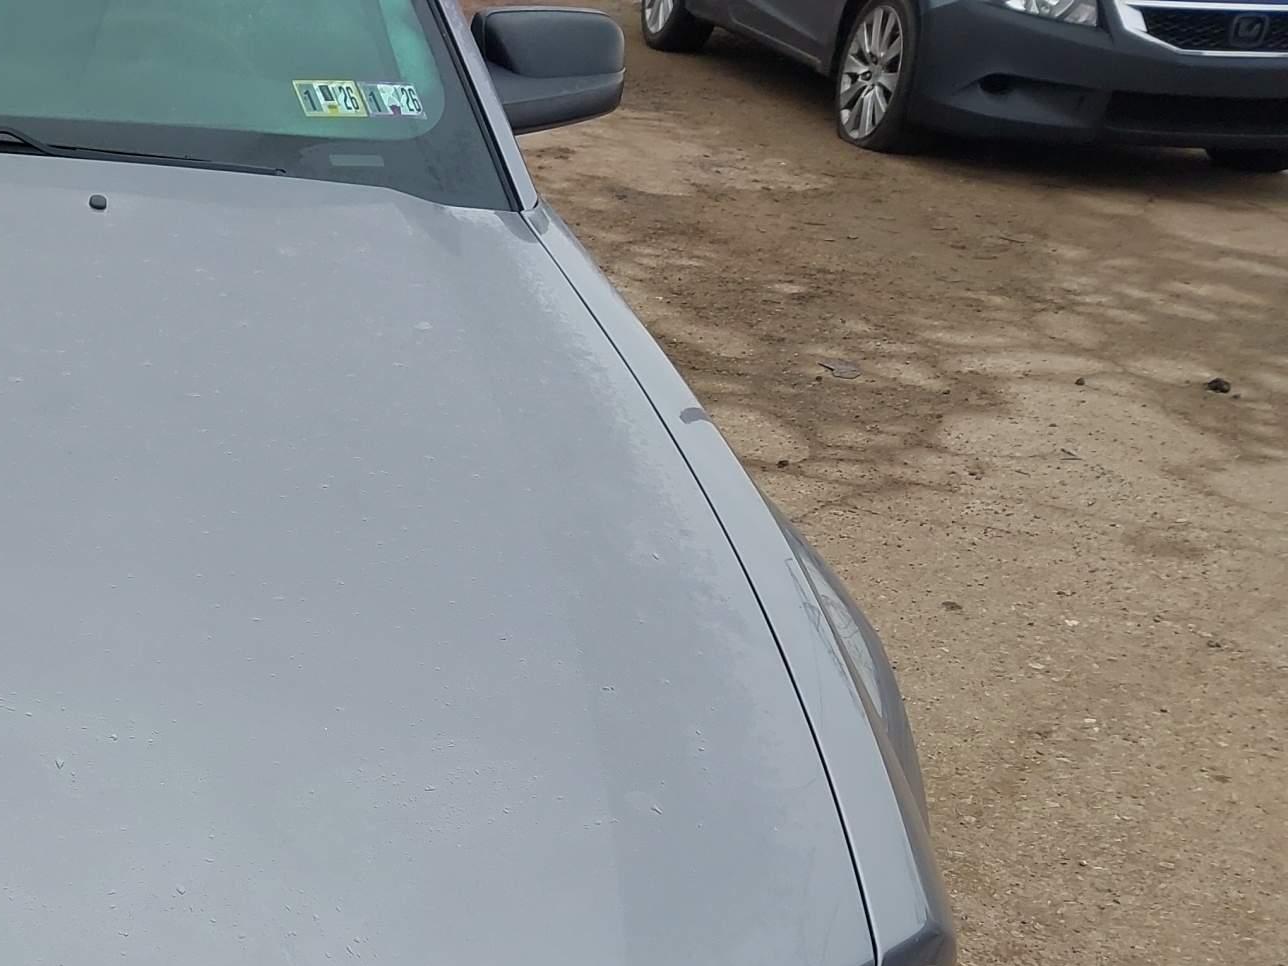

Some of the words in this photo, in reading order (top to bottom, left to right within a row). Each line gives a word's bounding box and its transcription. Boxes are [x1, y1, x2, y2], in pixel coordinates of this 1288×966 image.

[304, 89, 317, 111] 1
[338, 86, 360, 110] 26
[369, 91, 382, 112] 1
[400, 87, 422, 112] 26
